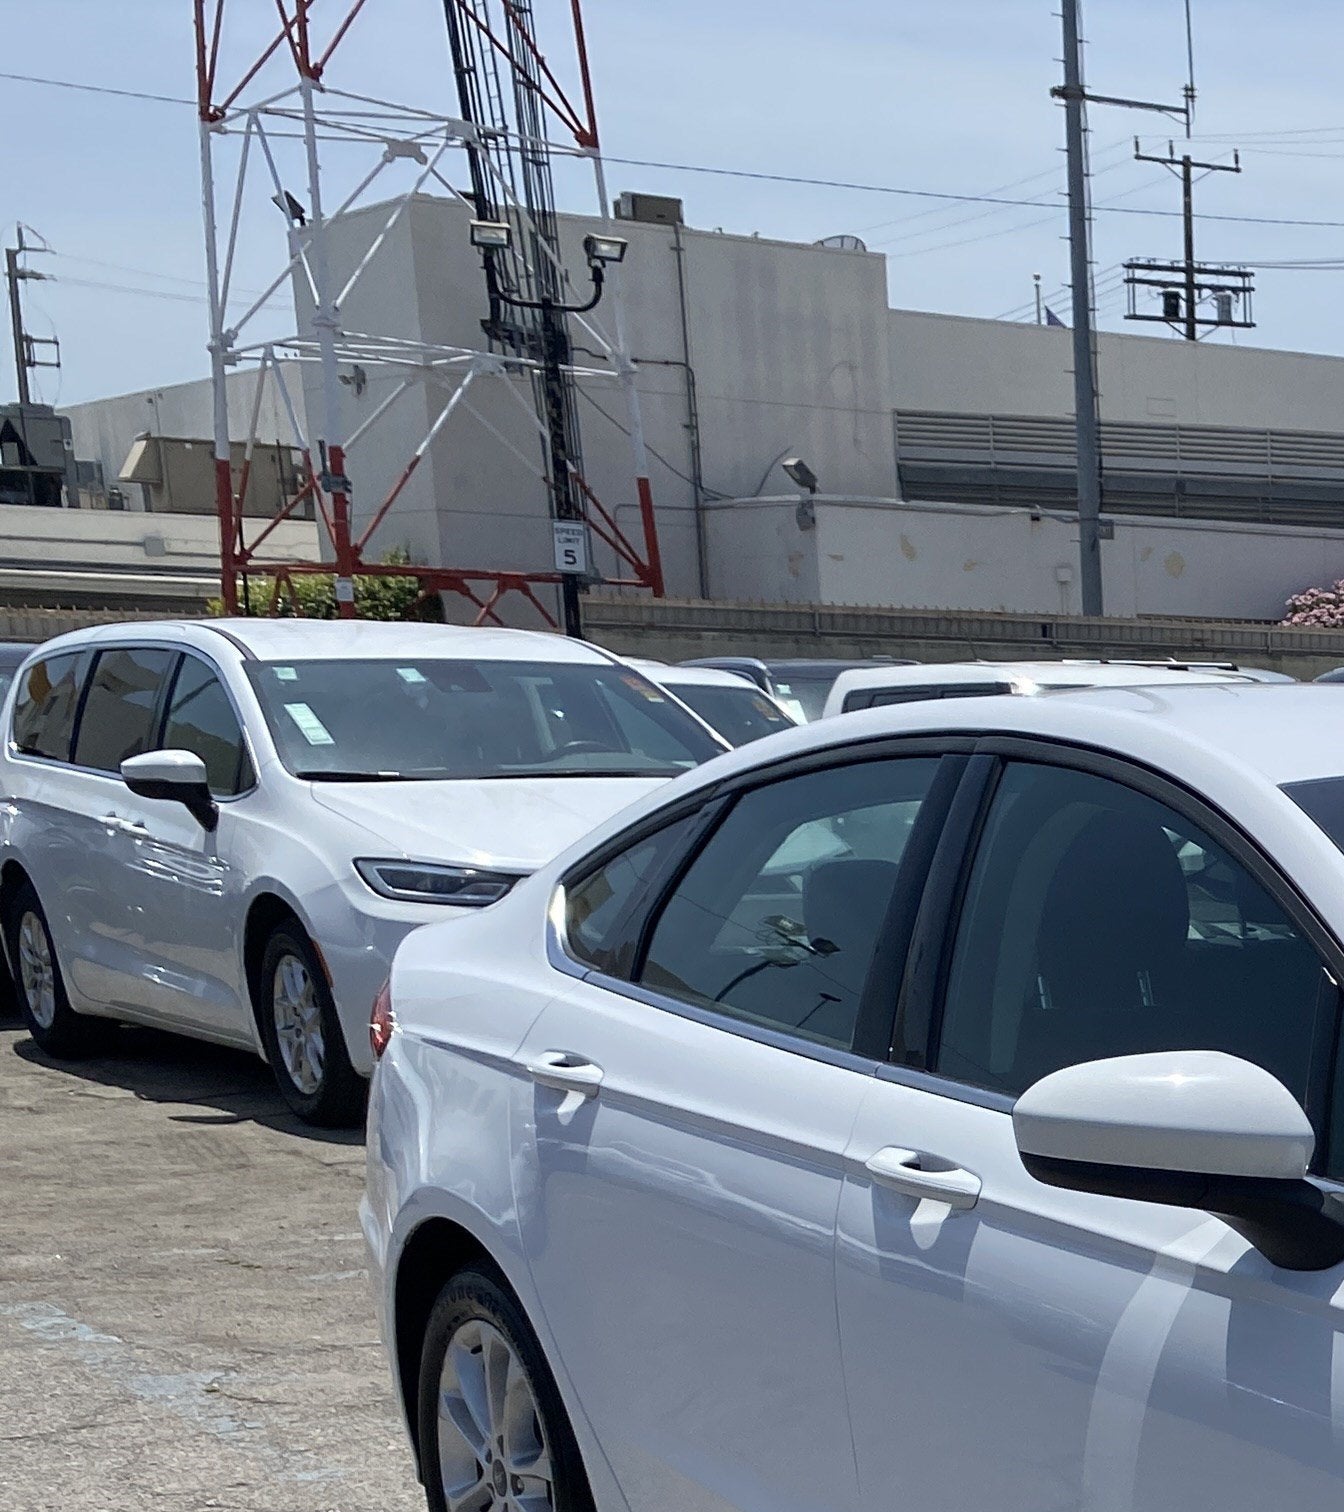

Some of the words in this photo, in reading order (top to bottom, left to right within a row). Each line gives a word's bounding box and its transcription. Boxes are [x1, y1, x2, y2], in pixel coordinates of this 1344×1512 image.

[555, 527, 583, 536] SPEED
[558, 536, 580, 545] LIMIT
[564, 549, 577, 565] 5
